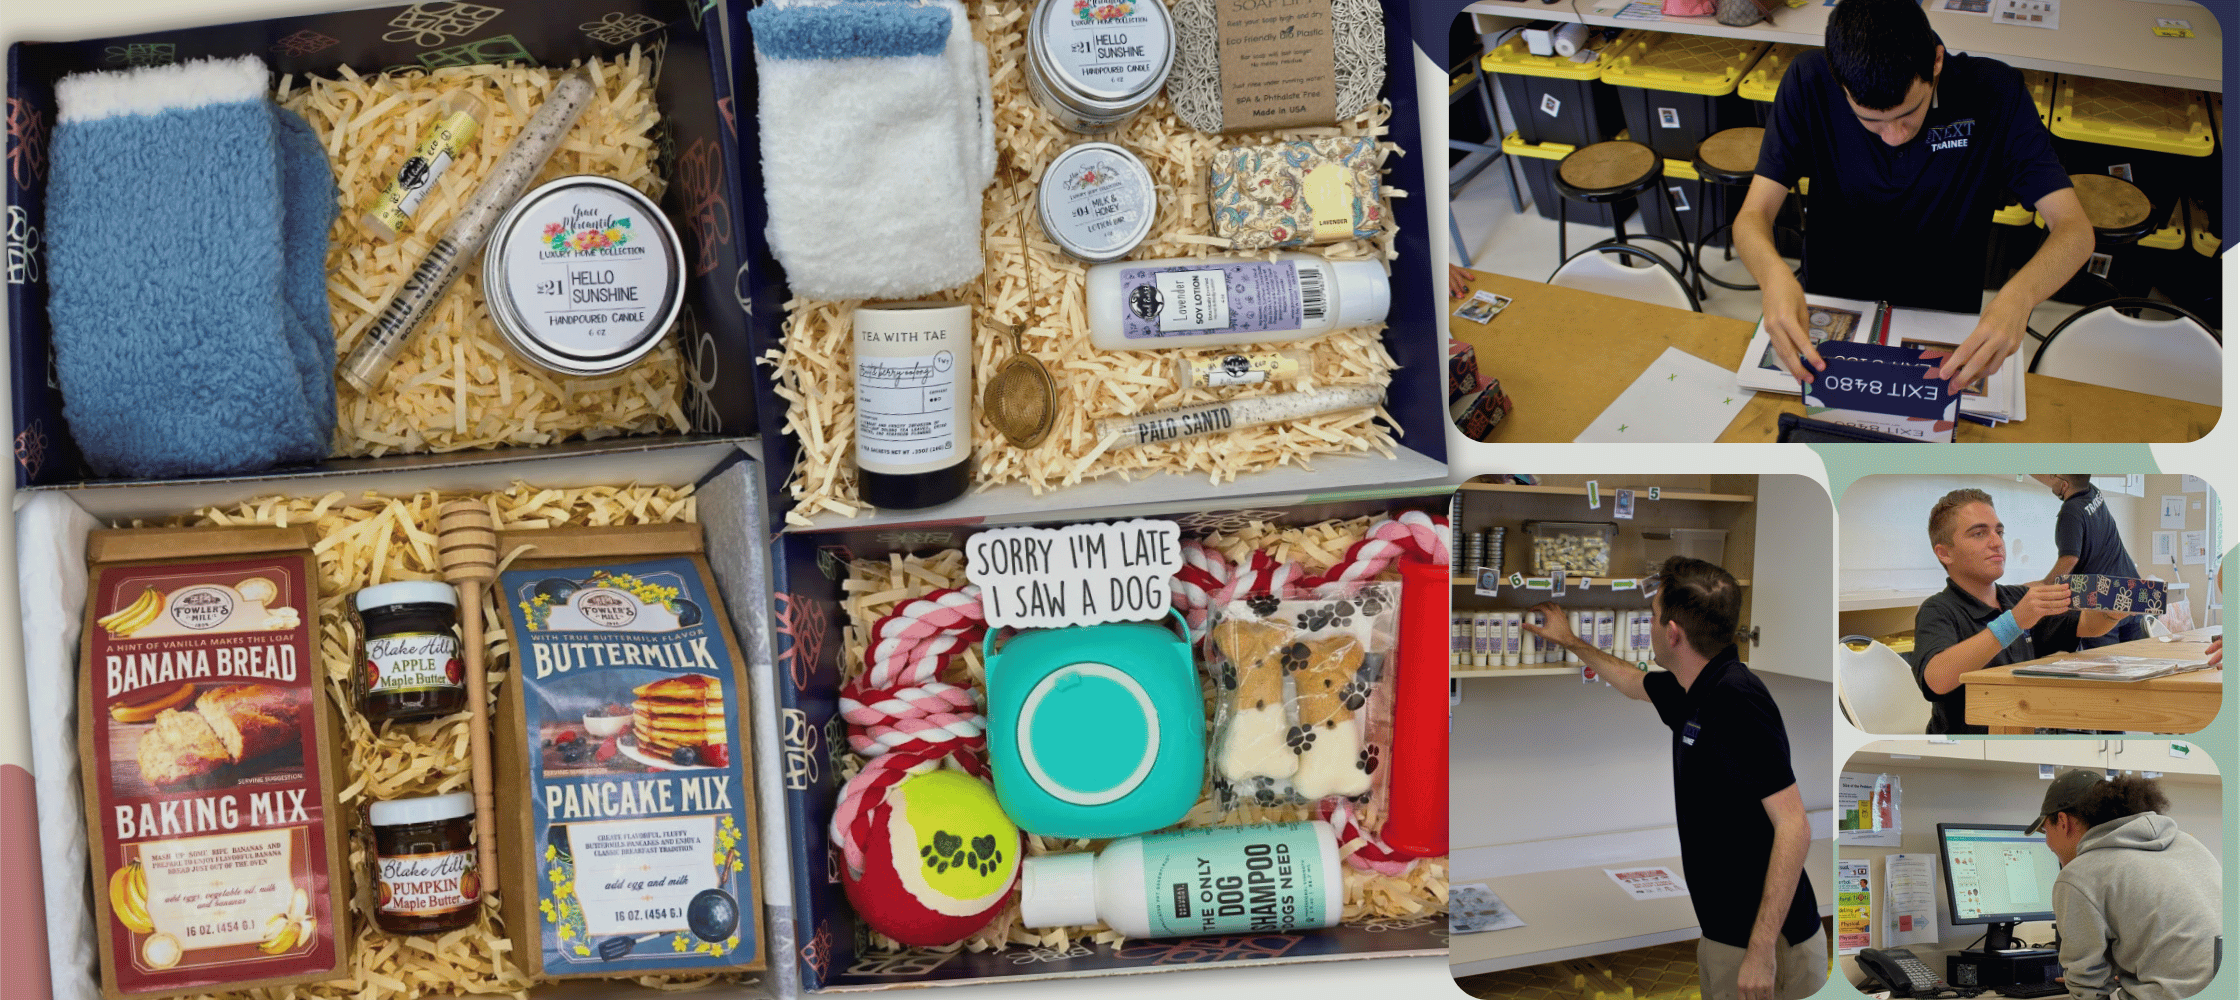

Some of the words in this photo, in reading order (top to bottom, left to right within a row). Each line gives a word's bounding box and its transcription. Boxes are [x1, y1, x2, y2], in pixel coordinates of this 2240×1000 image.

[1245, 18, 1260, 26] your
[1311, 11, 1323, 19] dry
[1096, 34, 1127, 45] HELLO
[1226, 37, 1241, 46] Eco
[1296, 28, 1324, 37] Plastic
[1098, 45, 1145, 59] SUNSHINE
[1082, 66, 1123, 76] HANDPOURED
[1127, 64, 1149, 73] CANDLE
[1237, 96, 1251, 105] BPA
[1264, 91, 1301, 102] Phthalate
[1303, 90, 1321, 98] Free
[1253, 108, 1276, 117] Made
[1278, 106, 1286, 114] in
[1289, 105, 1307, 114] USA
[1931, 121, 1976, 142] NEXT
[1931, 138, 1968, 152] TRAINEE
[1092, 197, 1110, 208] MILK
[1111, 194, 1117, 202] &
[573, 203, 598, 221] Grace
[1094, 203, 1120, 217] HONEY
[562, 214, 617, 231] Mercantile
[1318, 218, 1348, 226] LAVENDER
[539, 250, 570, 260] LUXURY
[575, 249, 597, 257] HOME
[600, 247, 645, 257] COLLECTION
[571, 269, 614, 286] HELLO
[368, 297, 413, 345] PALO
[404, 239, 457, 299] SANTO
[573, 287, 638, 303] SUNSHINE
[1192, 275, 1203, 306] LOTION
[400, 299, 433, 341] SOAKING
[433, 265, 458, 298] SALTS
[1171, 280, 1187, 321] Lavender
[550, 313, 607, 326] HANDPOURED
[612, 312, 645, 323] CANDLE
[1195, 308, 1204, 325] SOY
[862, 331, 881, 342] TEA
[884, 331, 918, 342] WITH
[923, 330, 947, 341] TAE
[1825, 375, 1883, 394] 8480
[1887, 383, 1939, 401] EXIT
[1138, 417, 1177, 443] PALO
[1182, 407, 1232, 436] SANTO
[1887, 426, 1925, 437] EXIT
[1650, 488, 1659, 499] 5
[977, 537, 1053, 576] SORRY
[1069, 533, 1107, 569] I'M
[1120, 529, 1172, 567] LATE
[1511, 573, 1522, 587] 6
[992, 585, 1001, 618] I
[1015, 580, 1065, 618] SAW
[1083, 578, 1097, 616] A
[1110, 575, 1162, 612] DOG
[174, 605, 229, 617] FOWLER'S
[107, 645, 113, 653] A
[117, 643, 141, 652] HINT
[146, 642, 159, 650] OF
[163, 639, 207, 649] VANILLA
[210, 637, 244, 646] MAKES
[247, 635, 266, 643] THE
[269, 634, 295, 642] LOAF
[593, 634, 658, 642] BUTTERMILK
[661, 629, 704, 642] FLAVOR
[372, 639, 417, 660] Blake
[418, 634, 450, 655] Hill
[391, 659, 436, 673] APPLE
[533, 636, 719, 680] BUTTERMILK
[106, 650, 211, 698] BANANA
[216, 643, 297, 682] BREAD
[380, 675, 413, 688] Maple
[416, 673, 446, 685] Butter
[238, 776, 264, 785] SERVING
[264, 773, 303, 783] SUGGESTION
[545, 779, 674, 819] PANCAKE
[680, 776, 733, 811] MIX
[114, 795, 239, 839] BAKING
[250, 789, 310, 827] MIX
[597, 834, 621, 842] CREATE
[627, 839, 659, 847] PANCAKES
[188, 850, 207, 858] SOME
[232, 844, 263, 854] BANANAS
[621, 846, 657, 855] BREAKFAST
[659, 845, 694, 853] TRADITION
[152, 861, 182, 869] PREPARE
[254, 850, 282, 859] BANANA
[167, 867, 190, 875] BREAD
[192, 865, 208, 873] JUST
[250, 859, 268, 867] OVEN
[383, 859, 430, 879] Blake
[431, 854, 464, 876] Hill
[1276, 843, 1293, 889] NEED
[393, 878, 458, 895] PUMPKIN
[604, 878, 625, 890] add
[627, 881, 644, 892] egg
[647, 876, 667, 887] and
[667, 875, 689, 886] milk
[1197, 857, 1213, 903] ONLY
[1244, 843, 1277, 931] SHAMPOO
[164, 894, 181, 903] add
[197, 899, 213, 909] and
[214, 898, 246, 908] bananas
[393, 897, 427, 911] Maple
[429, 895, 461, 908] Butter
[1215, 876, 1245, 917] DOG
[615, 911, 625, 922] 16
[628, 910, 643, 921] OZ.
[645, 909, 667, 920] (454
[1202, 908, 1216, 931] THE
[186, 926, 197, 937] 16
[199, 924, 215, 936] OZ.
[217, 920, 240, 934] (454
